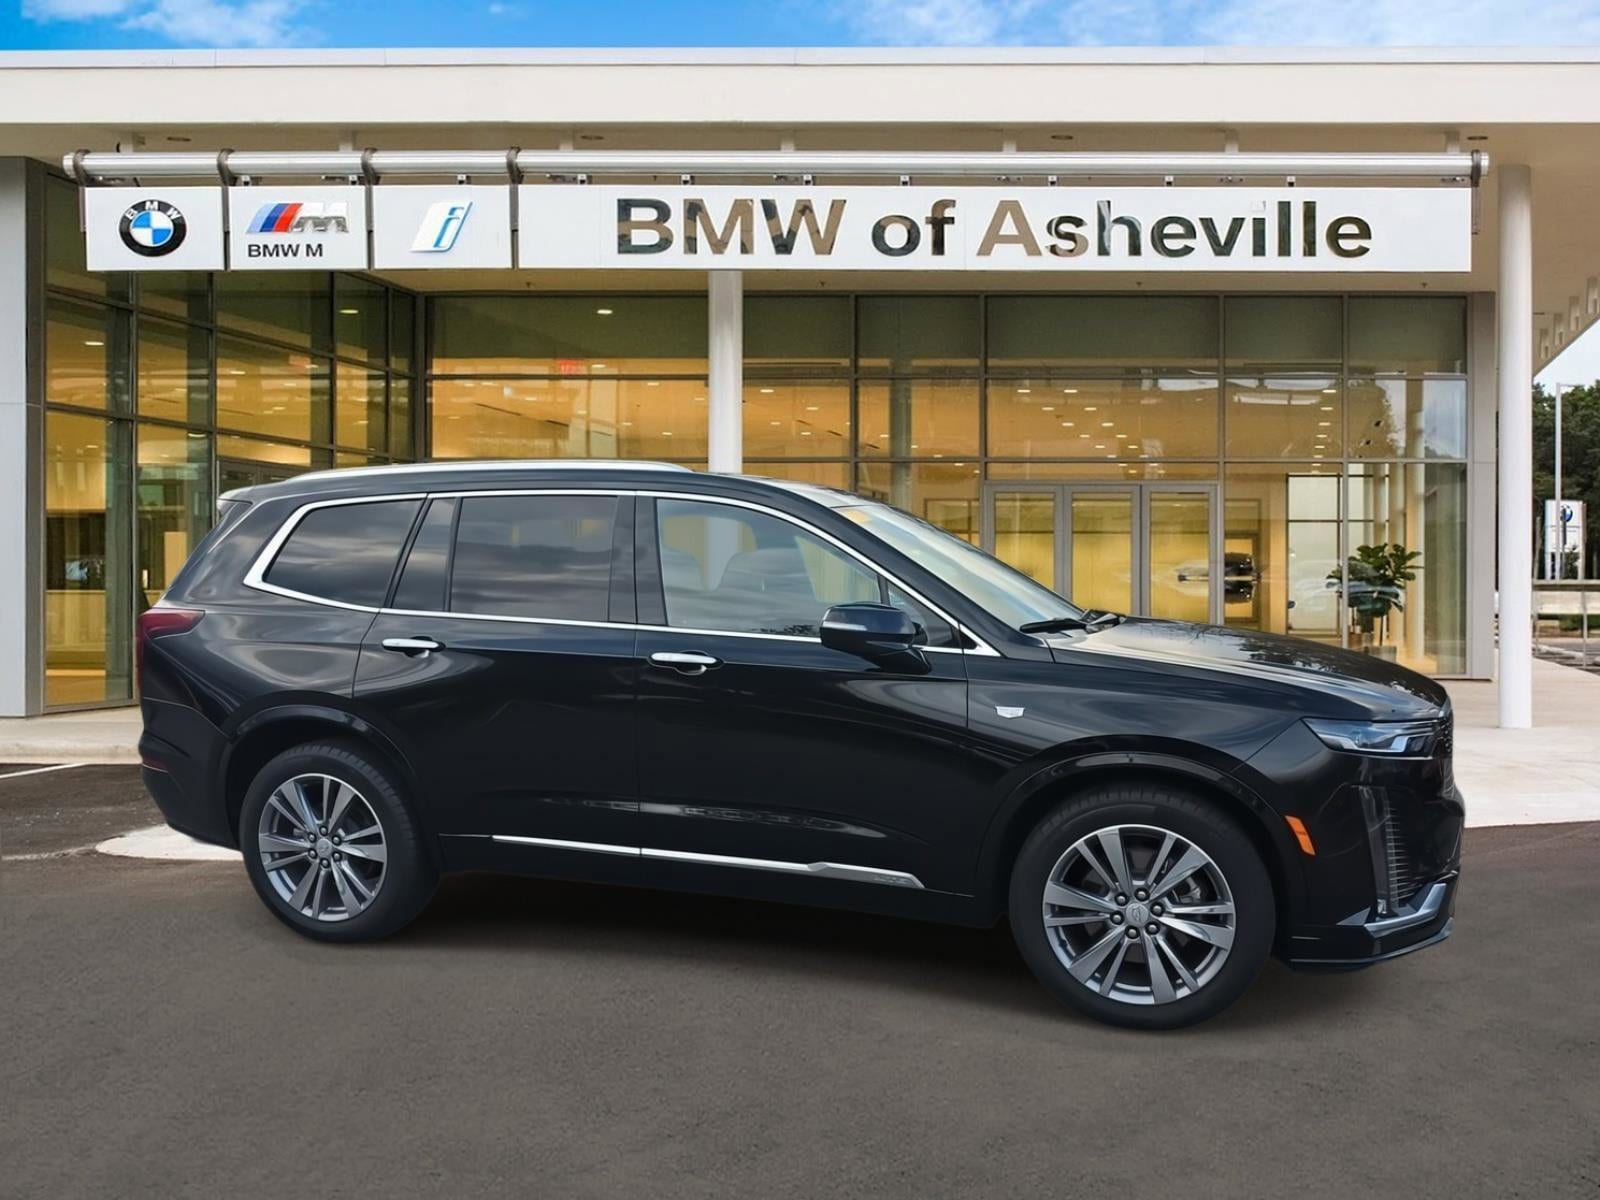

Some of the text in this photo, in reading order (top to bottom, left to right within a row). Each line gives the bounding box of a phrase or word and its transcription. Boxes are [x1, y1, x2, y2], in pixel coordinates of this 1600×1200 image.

[125, 200, 181, 220] BMW
[617, 198, 1373, 257] BMW of Asheville
[247, 243, 324, 258] BMW M
